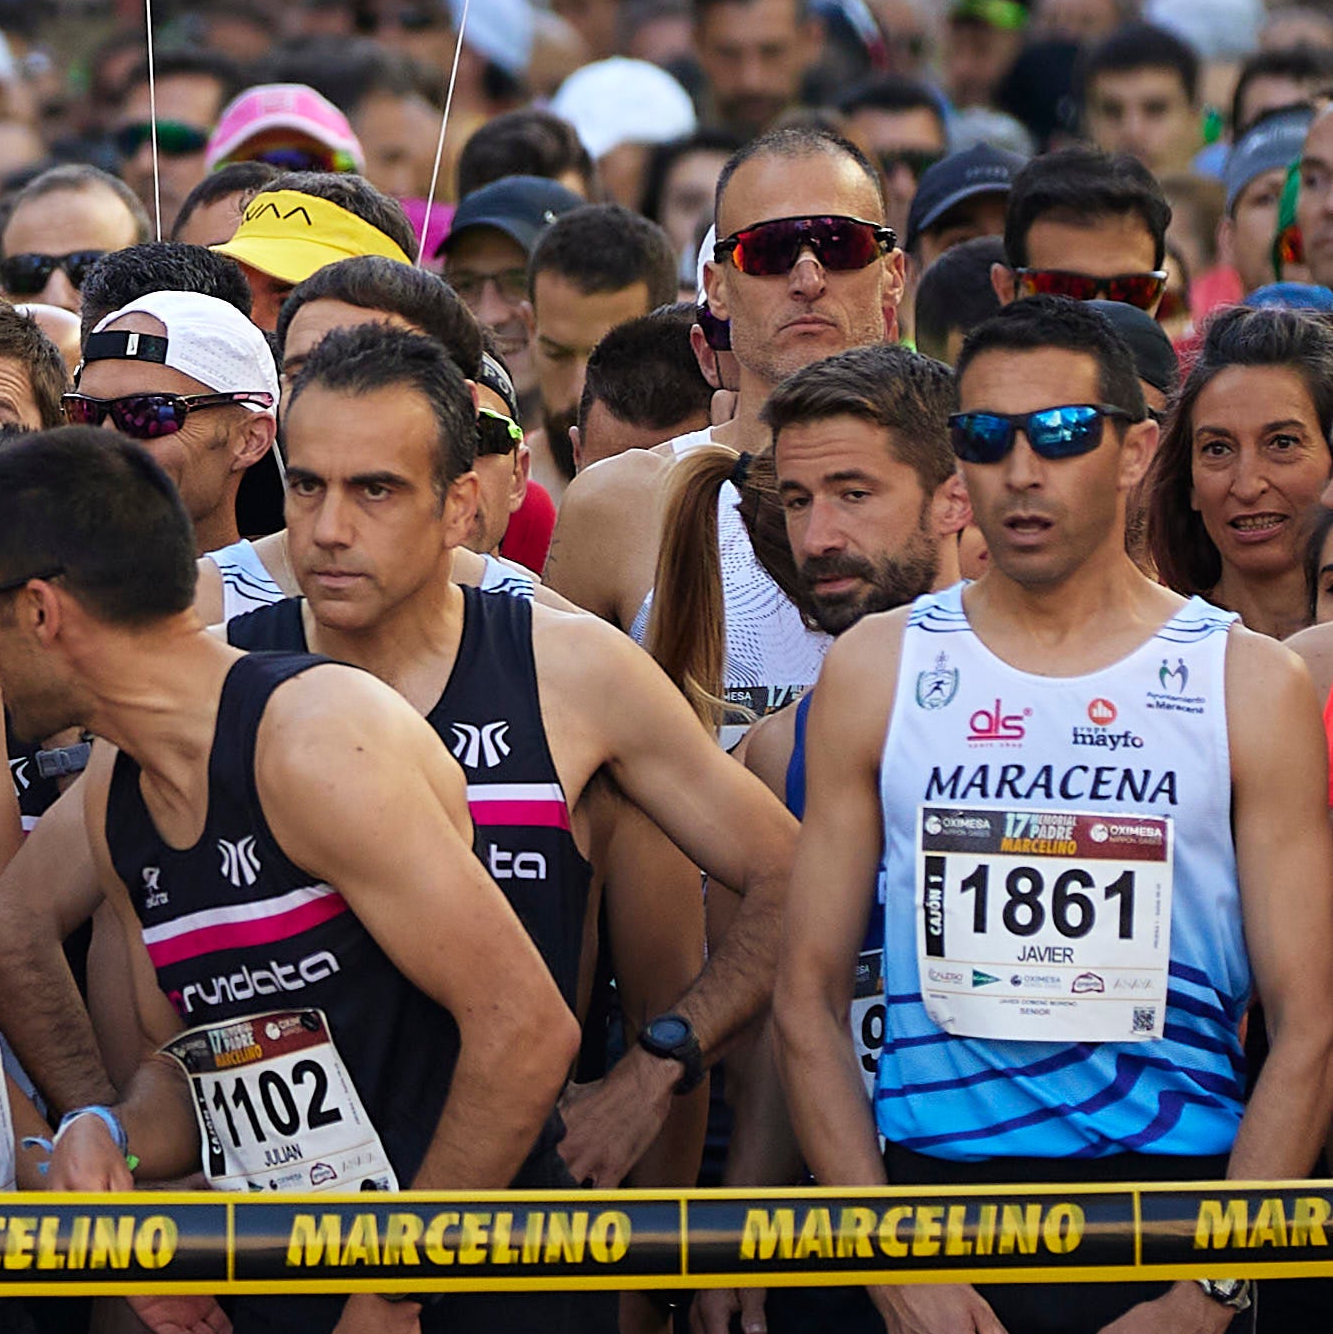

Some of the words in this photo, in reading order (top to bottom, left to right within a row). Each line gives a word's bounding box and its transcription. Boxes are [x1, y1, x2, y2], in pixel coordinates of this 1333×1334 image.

[1072, 730, 1144, 751] mayfo
[924, 763, 1179, 806] MARACENA
[942, 818, 992, 831] OXIMESA
[1005, 813, 1029, 839] 17
[1030, 825, 1074, 841] PADRE
[1109, 826, 1164, 839] OXIMESA
[1000, 838, 1078, 856] MARCELINO
[960, 864, 1137, 941] 1861
[1017, 945, 1075, 965] JAVIER
[212, 1059, 344, 1149] 1102
[264, 1144, 304, 1168] JULIAN
[287, 1211, 632, 1266] MARCELINO
[741, 1203, 1085, 1259] MARCELINO
